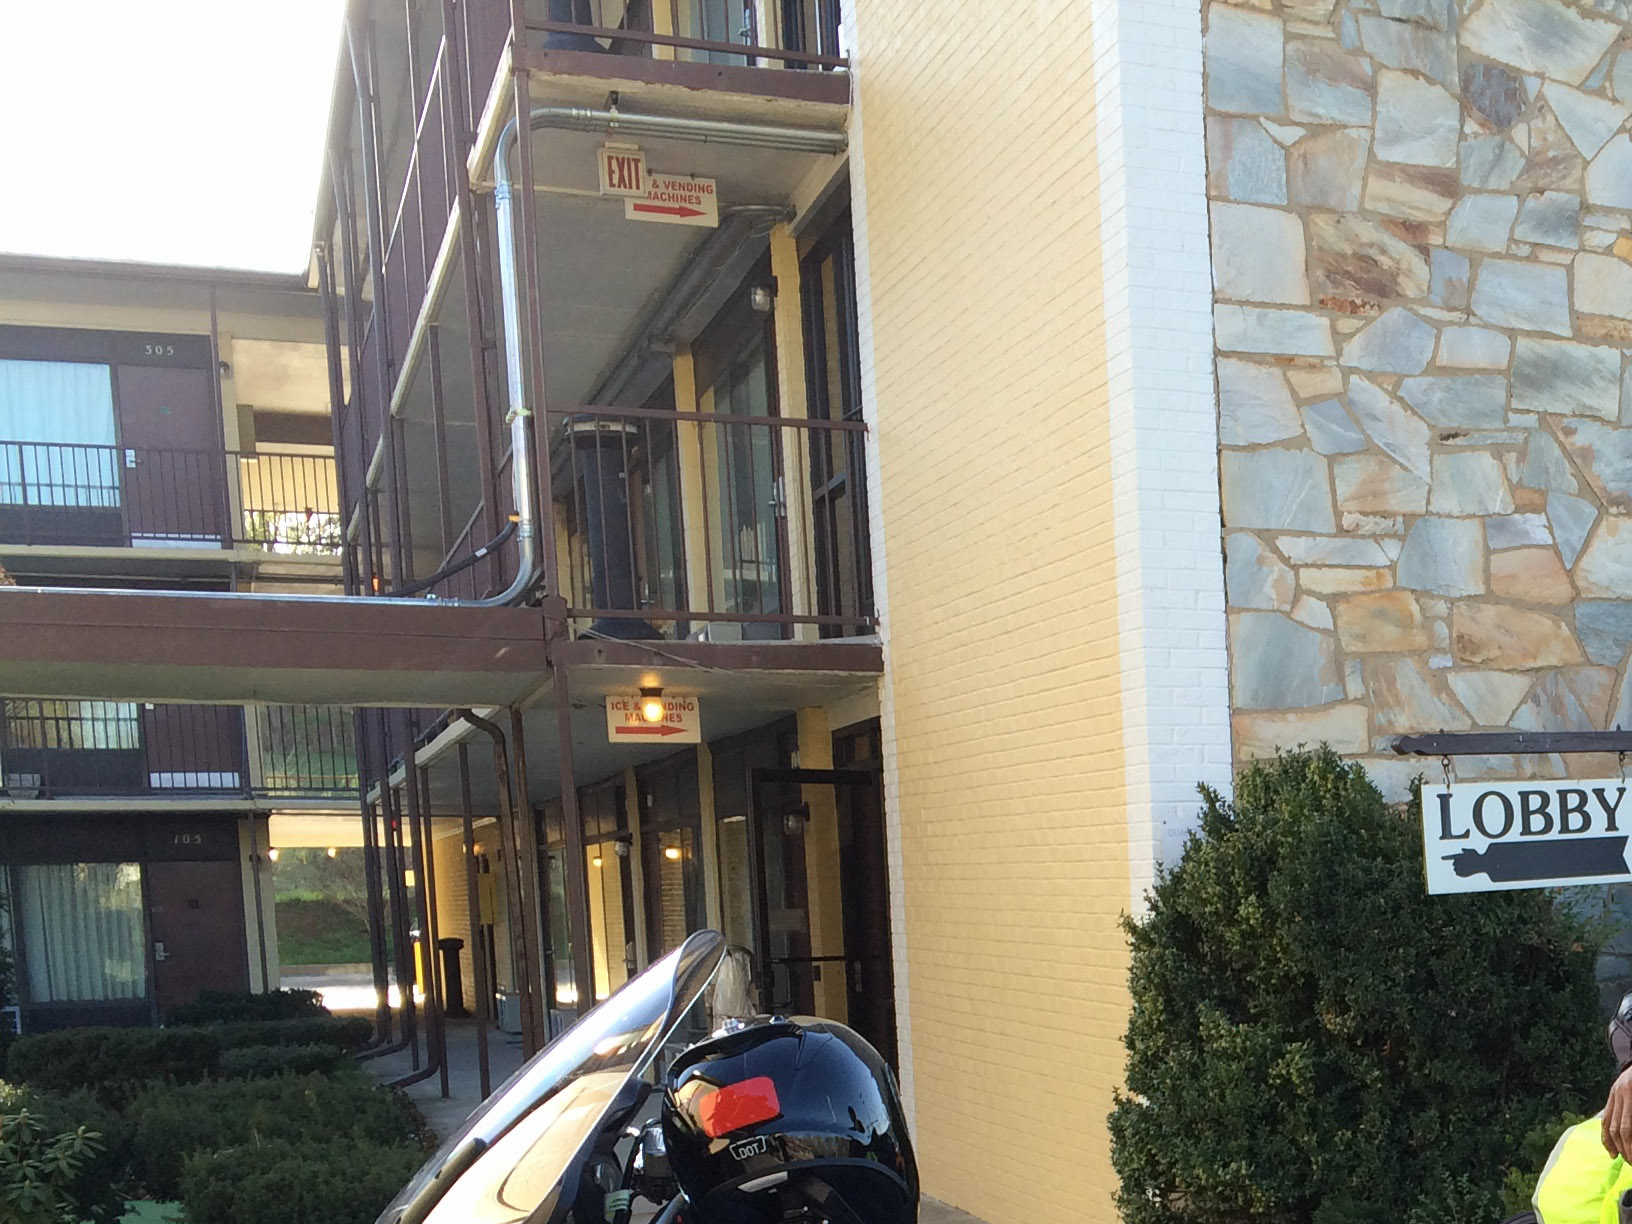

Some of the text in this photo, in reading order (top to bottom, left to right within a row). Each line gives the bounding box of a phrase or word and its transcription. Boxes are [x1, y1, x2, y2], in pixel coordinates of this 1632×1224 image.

[607, 155, 641, 191] EXIT
[651, 179, 714, 194] & VENDING
[145, 344, 174, 356] 305
[611, 702, 629, 711] ICE
[1437, 787, 1627, 840] LOBBY
[739, 1143, 759, 1159] DOT
